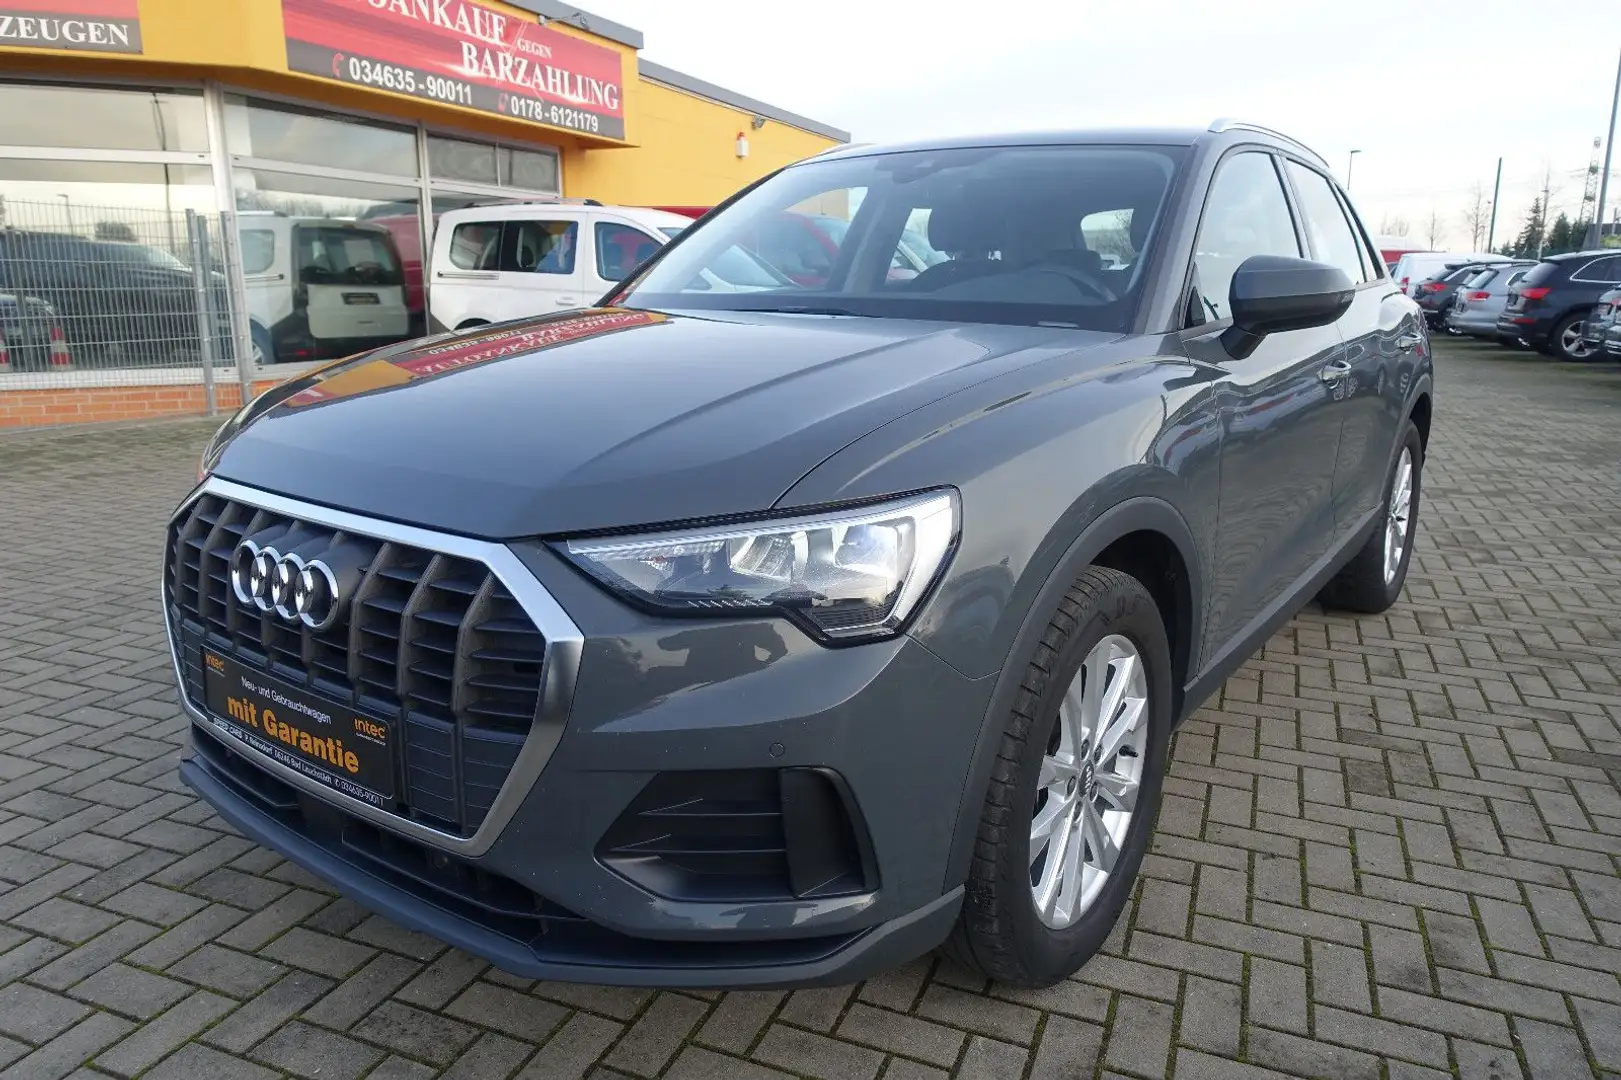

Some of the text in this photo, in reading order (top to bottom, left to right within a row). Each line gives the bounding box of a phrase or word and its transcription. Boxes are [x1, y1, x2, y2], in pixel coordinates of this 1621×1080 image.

[0, 15, 129, 46] ZEUGEN
[517, 38, 552, 58] GEGEN
[459, 41, 619, 110] BARZAHLUNG
[258, 686, 271, 699] und
[271, 690, 332, 725] Gebrauchtwagen
[227, 696, 359, 773] mit Garantie
